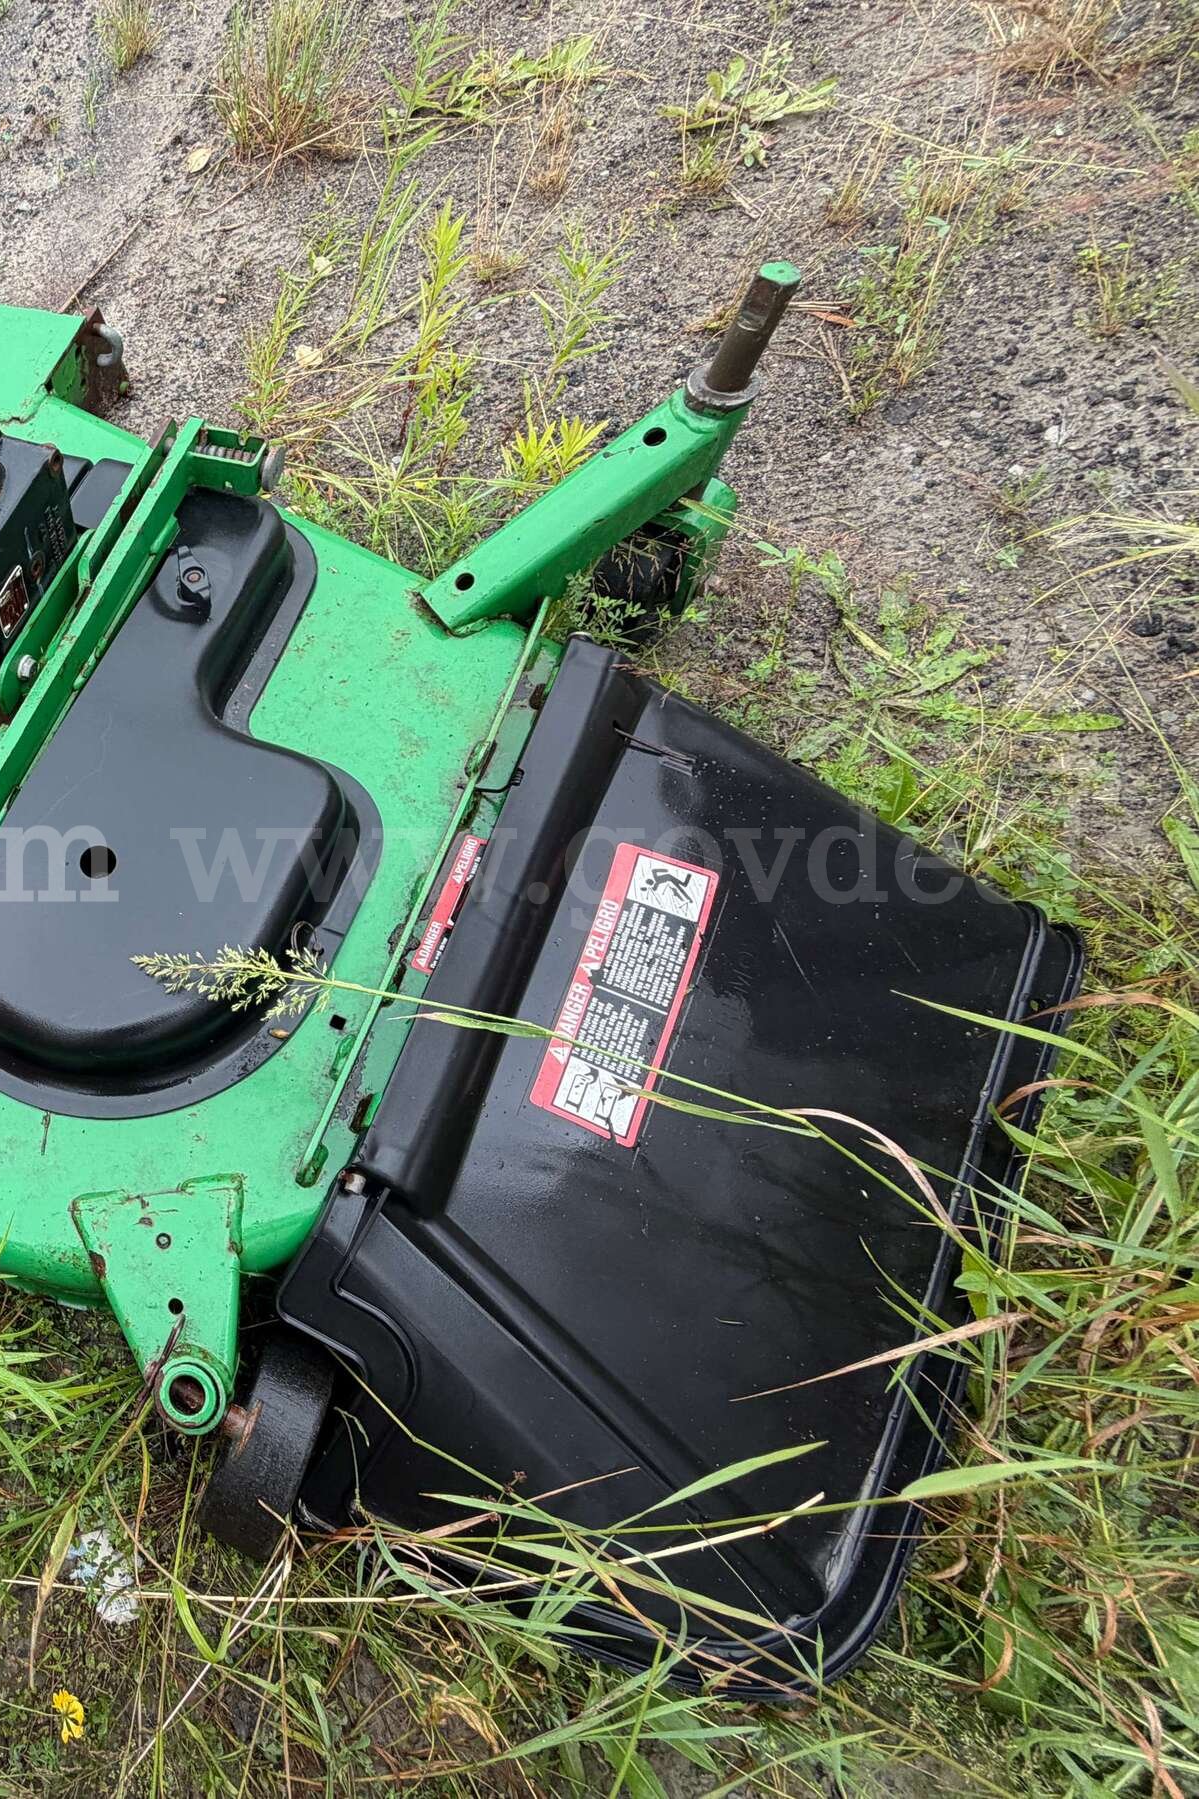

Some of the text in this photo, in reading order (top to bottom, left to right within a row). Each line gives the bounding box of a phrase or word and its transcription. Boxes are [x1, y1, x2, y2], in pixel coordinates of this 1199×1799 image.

[420, 838, 478, 957] DANGER PELIGRO
[588, 898, 619, 957] PELIGRO
